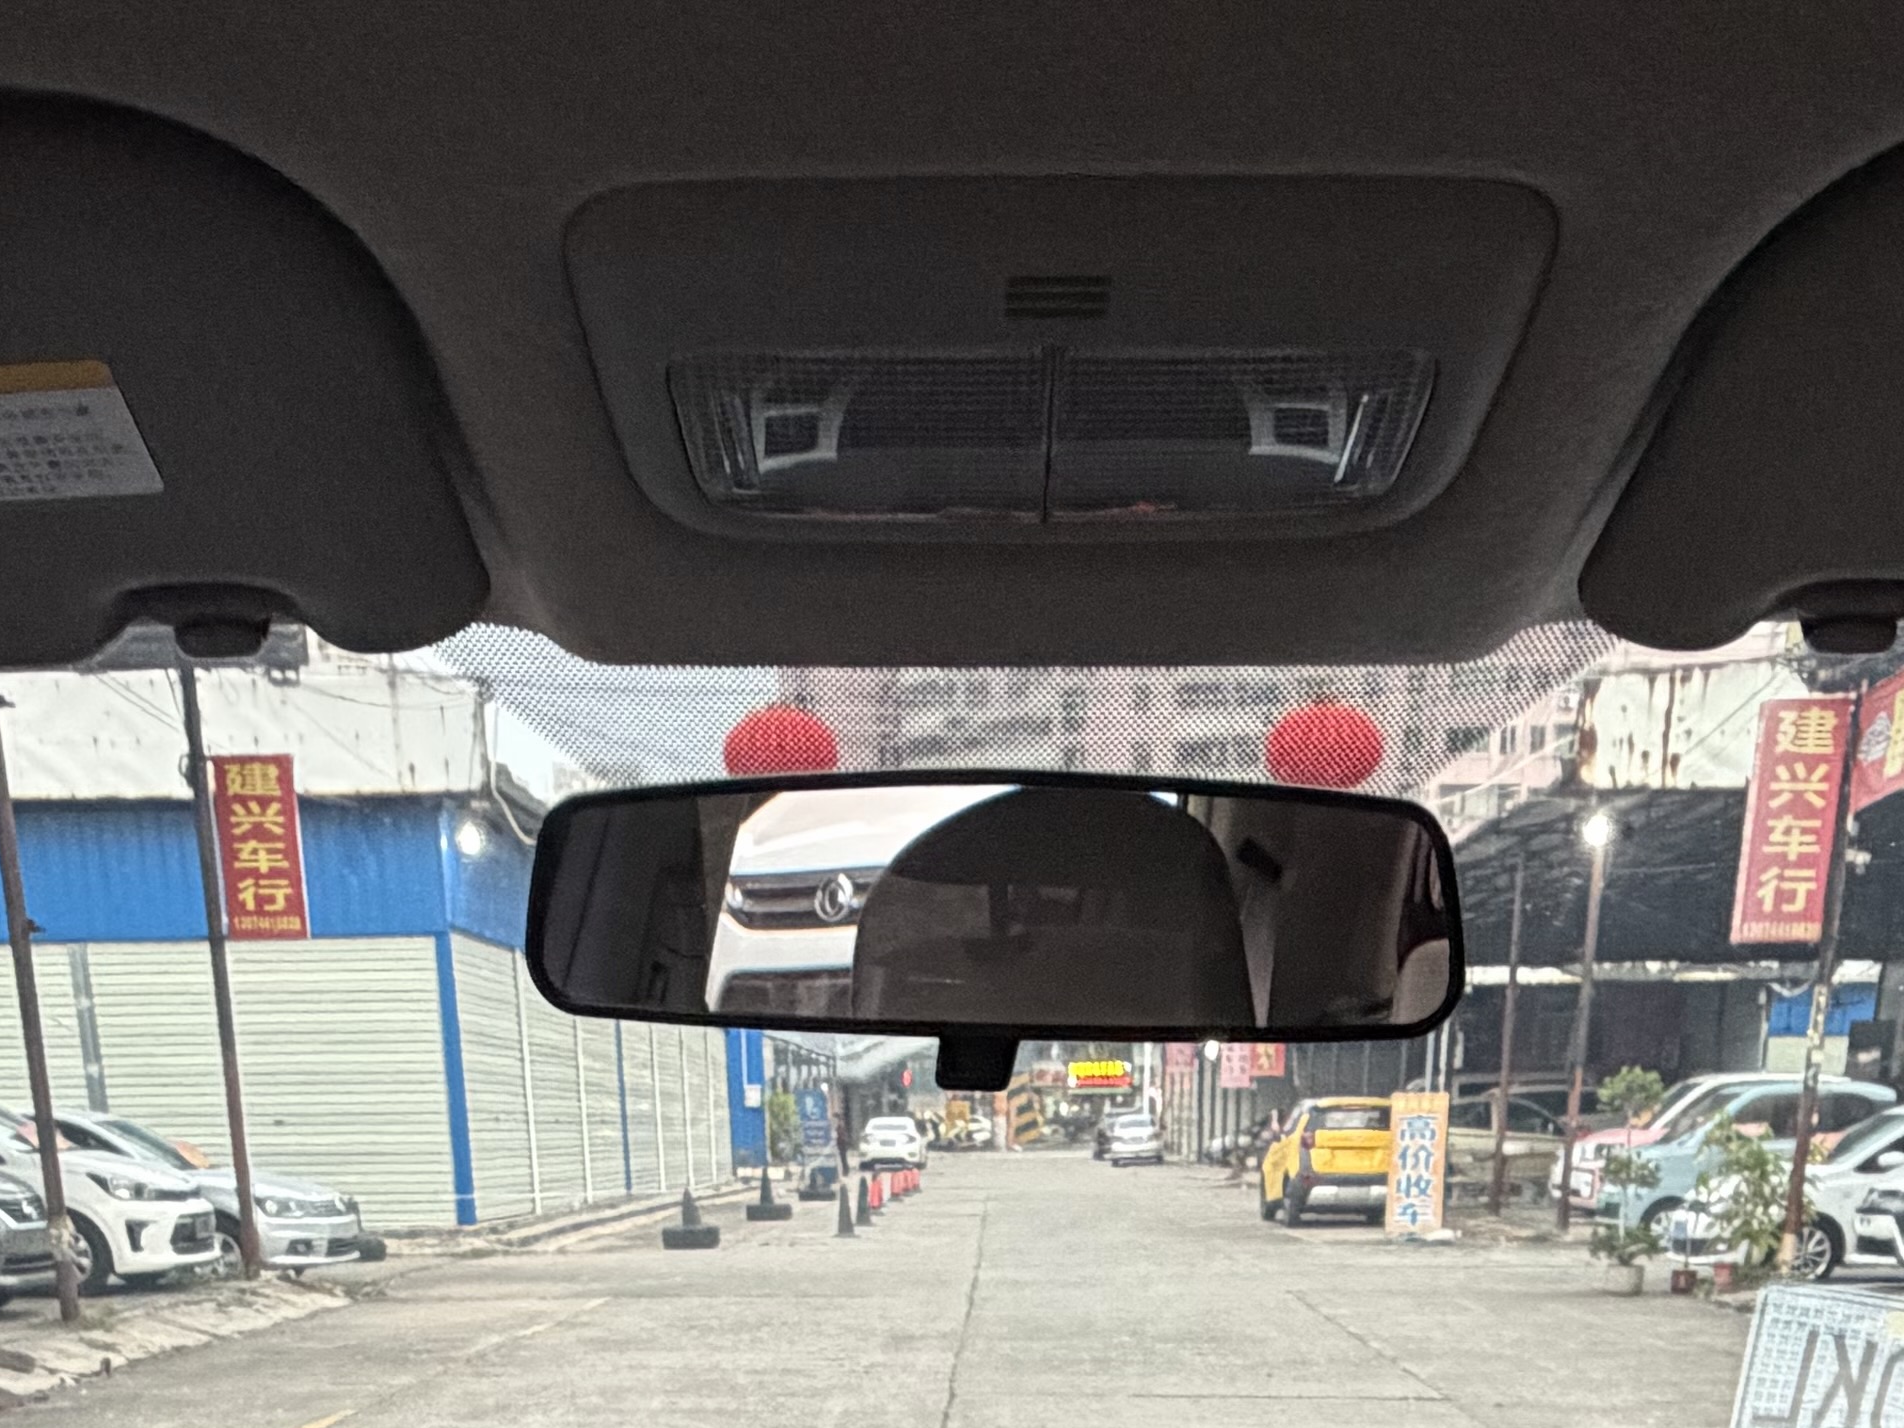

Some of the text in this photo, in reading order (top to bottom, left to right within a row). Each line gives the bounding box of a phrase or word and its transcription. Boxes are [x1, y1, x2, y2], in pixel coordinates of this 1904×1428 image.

[224, 762, 293, 911] 建兴车行
[1756, 706, 1839, 913] 建兴车行
[1396, 1115, 1437, 1226] 高价收车
